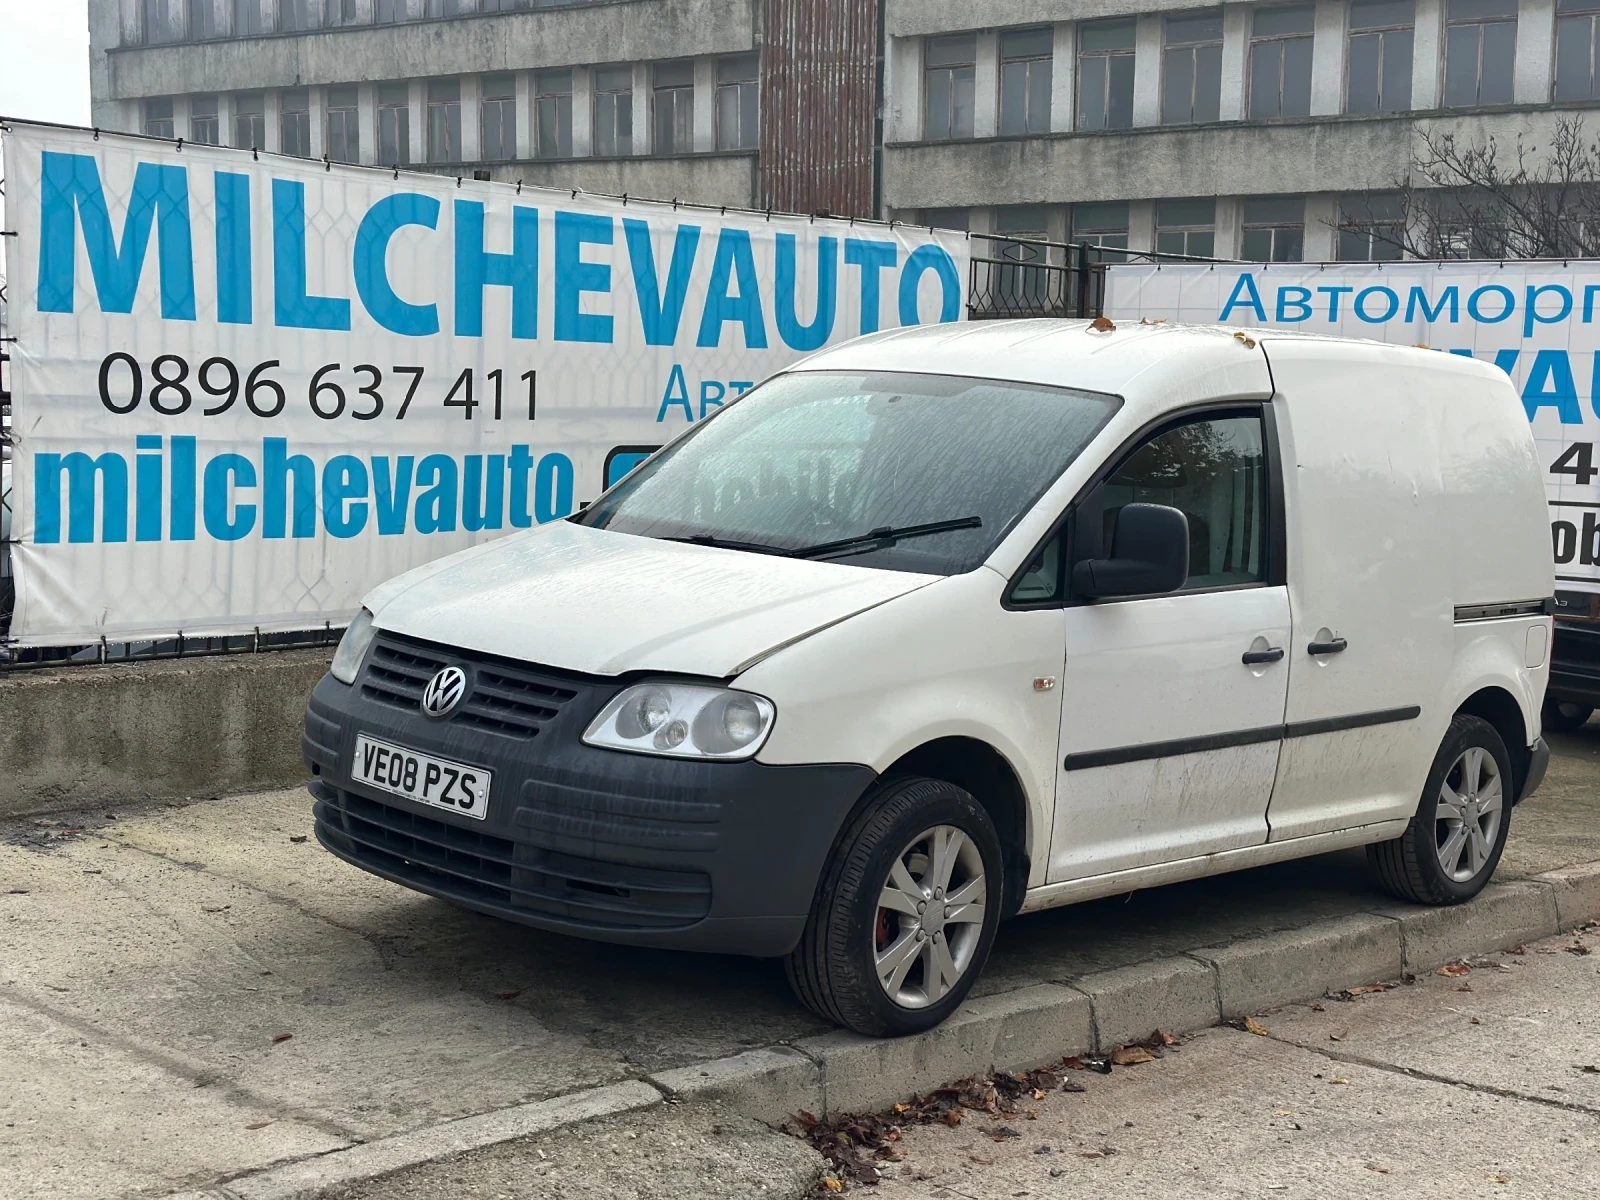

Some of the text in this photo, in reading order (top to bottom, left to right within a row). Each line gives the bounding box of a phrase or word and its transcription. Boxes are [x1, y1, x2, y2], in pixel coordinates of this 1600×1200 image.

[37, 150, 961, 352] MILCHEVAUTO
[98, 352, 537, 421] 0896 637 411
[363, 742, 478, 810] VE08 PZS
